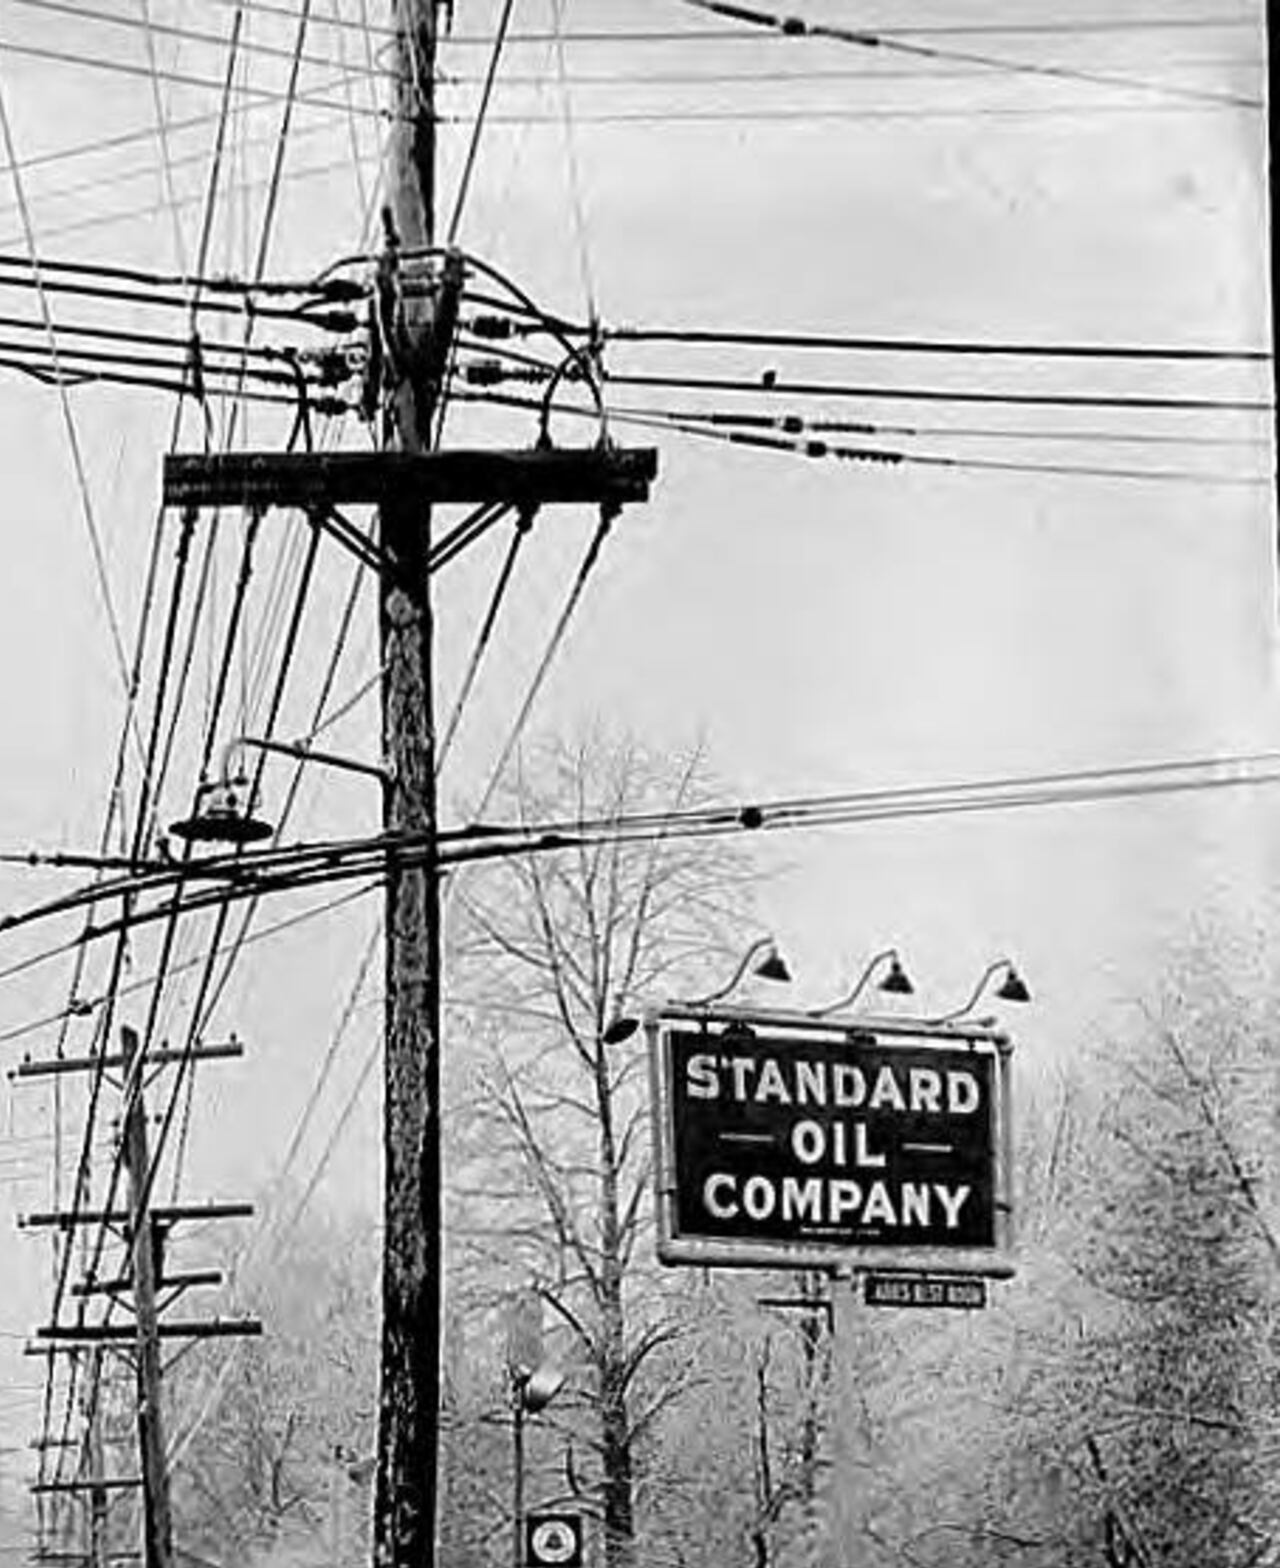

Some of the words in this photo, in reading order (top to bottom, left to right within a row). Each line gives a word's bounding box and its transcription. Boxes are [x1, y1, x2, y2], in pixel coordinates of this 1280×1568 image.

[686, 1053, 981, 1114] STANDARD
[790, 1120, 887, 1168] OIL
[702, 1173, 972, 1228] COMPANY
